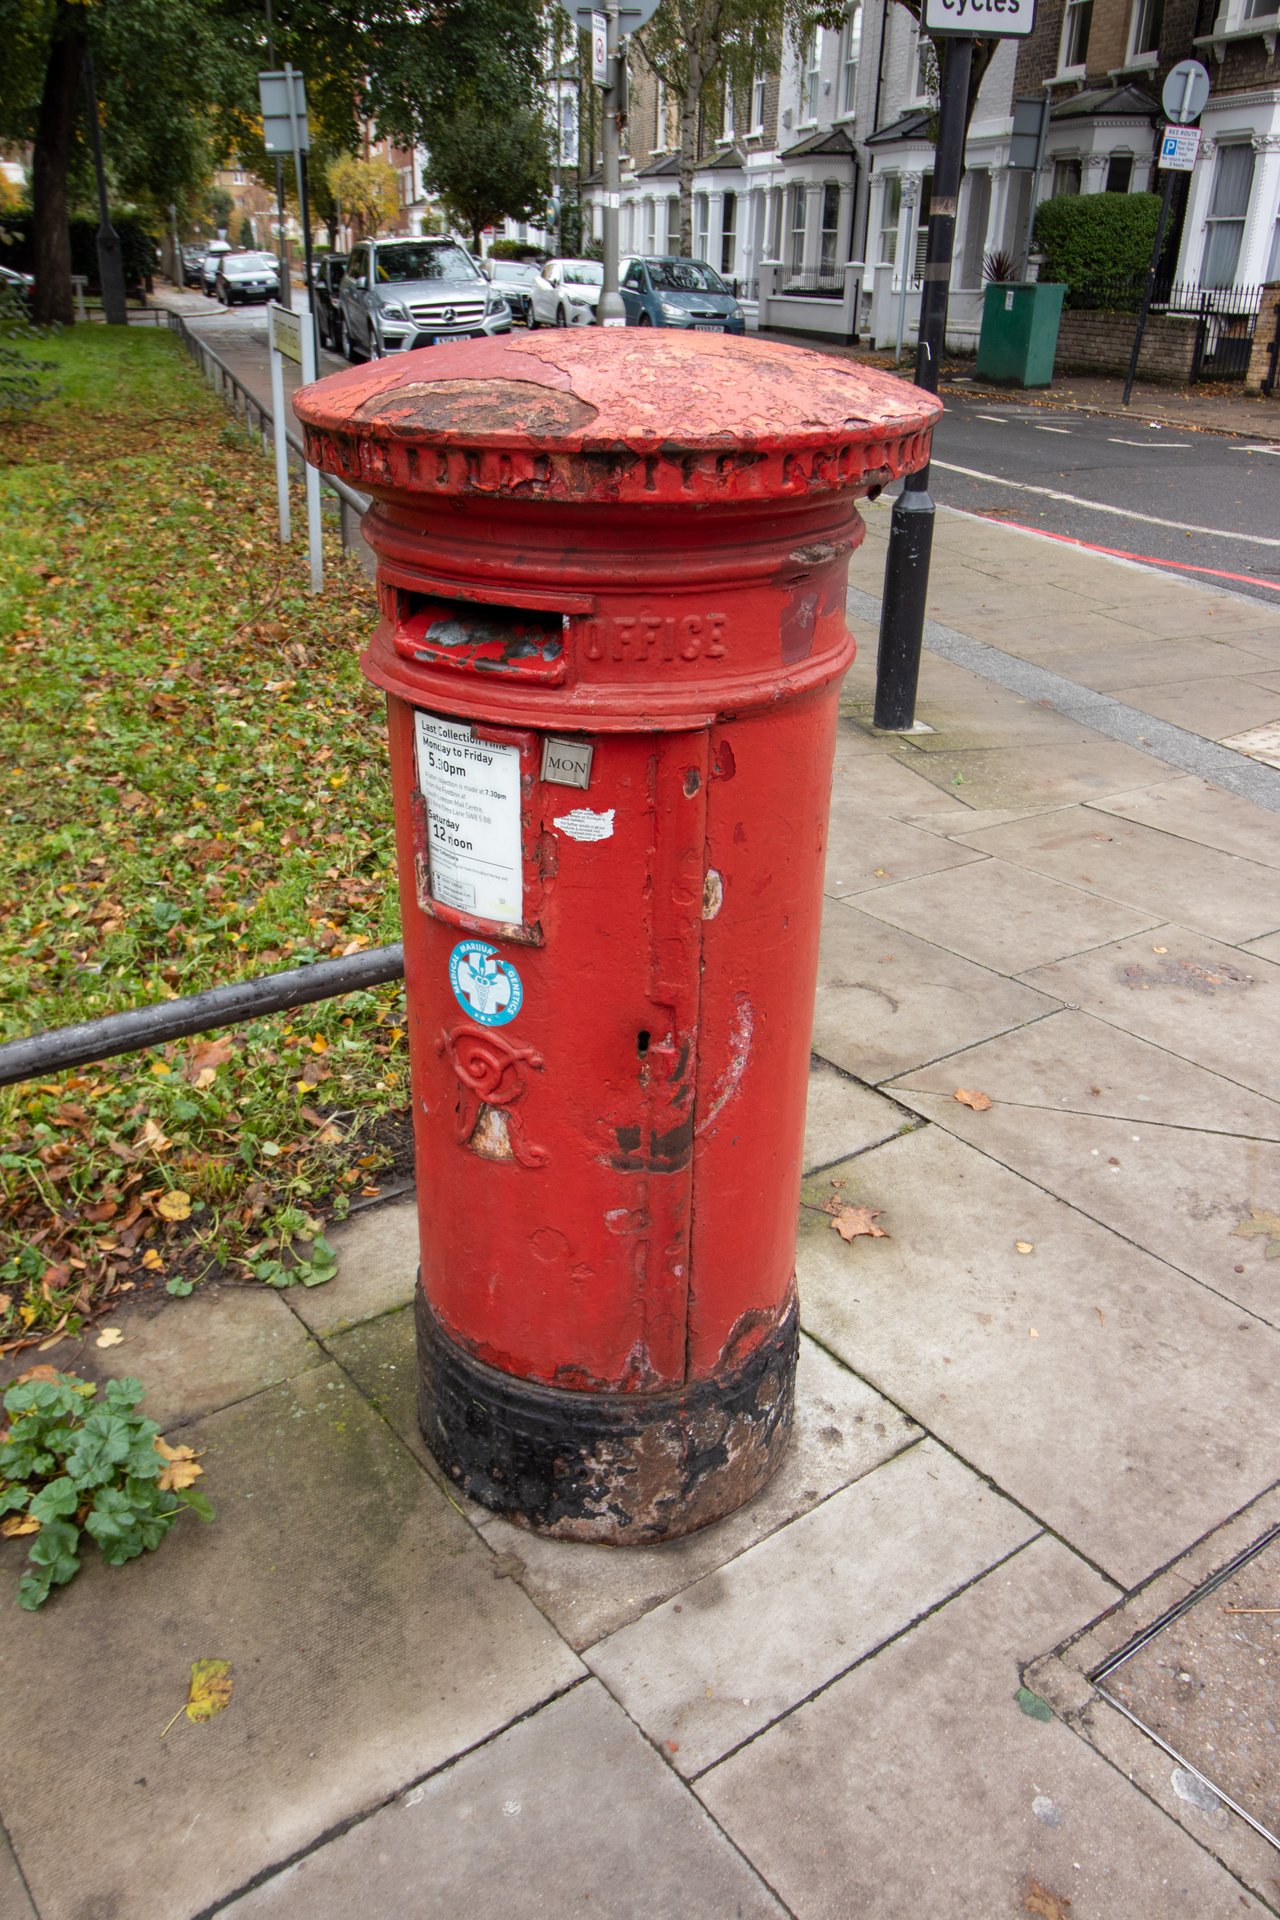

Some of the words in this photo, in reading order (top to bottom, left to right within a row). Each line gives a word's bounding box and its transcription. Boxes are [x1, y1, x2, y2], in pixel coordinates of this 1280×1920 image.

[1180, 130, 1198, 138] ROUTE
[421, 720, 437, 735] Last
[438, 726, 481, 745] Collection
[422, 736, 451, 757] Monday
[453, 747, 462, 758] to
[464, 748, 494, 766] Friday
[428, 751, 466, 777] 5.30pm
[548, 756, 587, 774] MON
[485, 789, 507, 801] 7.30pm
[428, 809, 460, 831] Saturday
[433, 823, 446, 842] 12
[448, 835, 473, 851] noon
[450, 954, 461, 994] MEDICAL
[507, 970, 520, 1015] GENETICS
